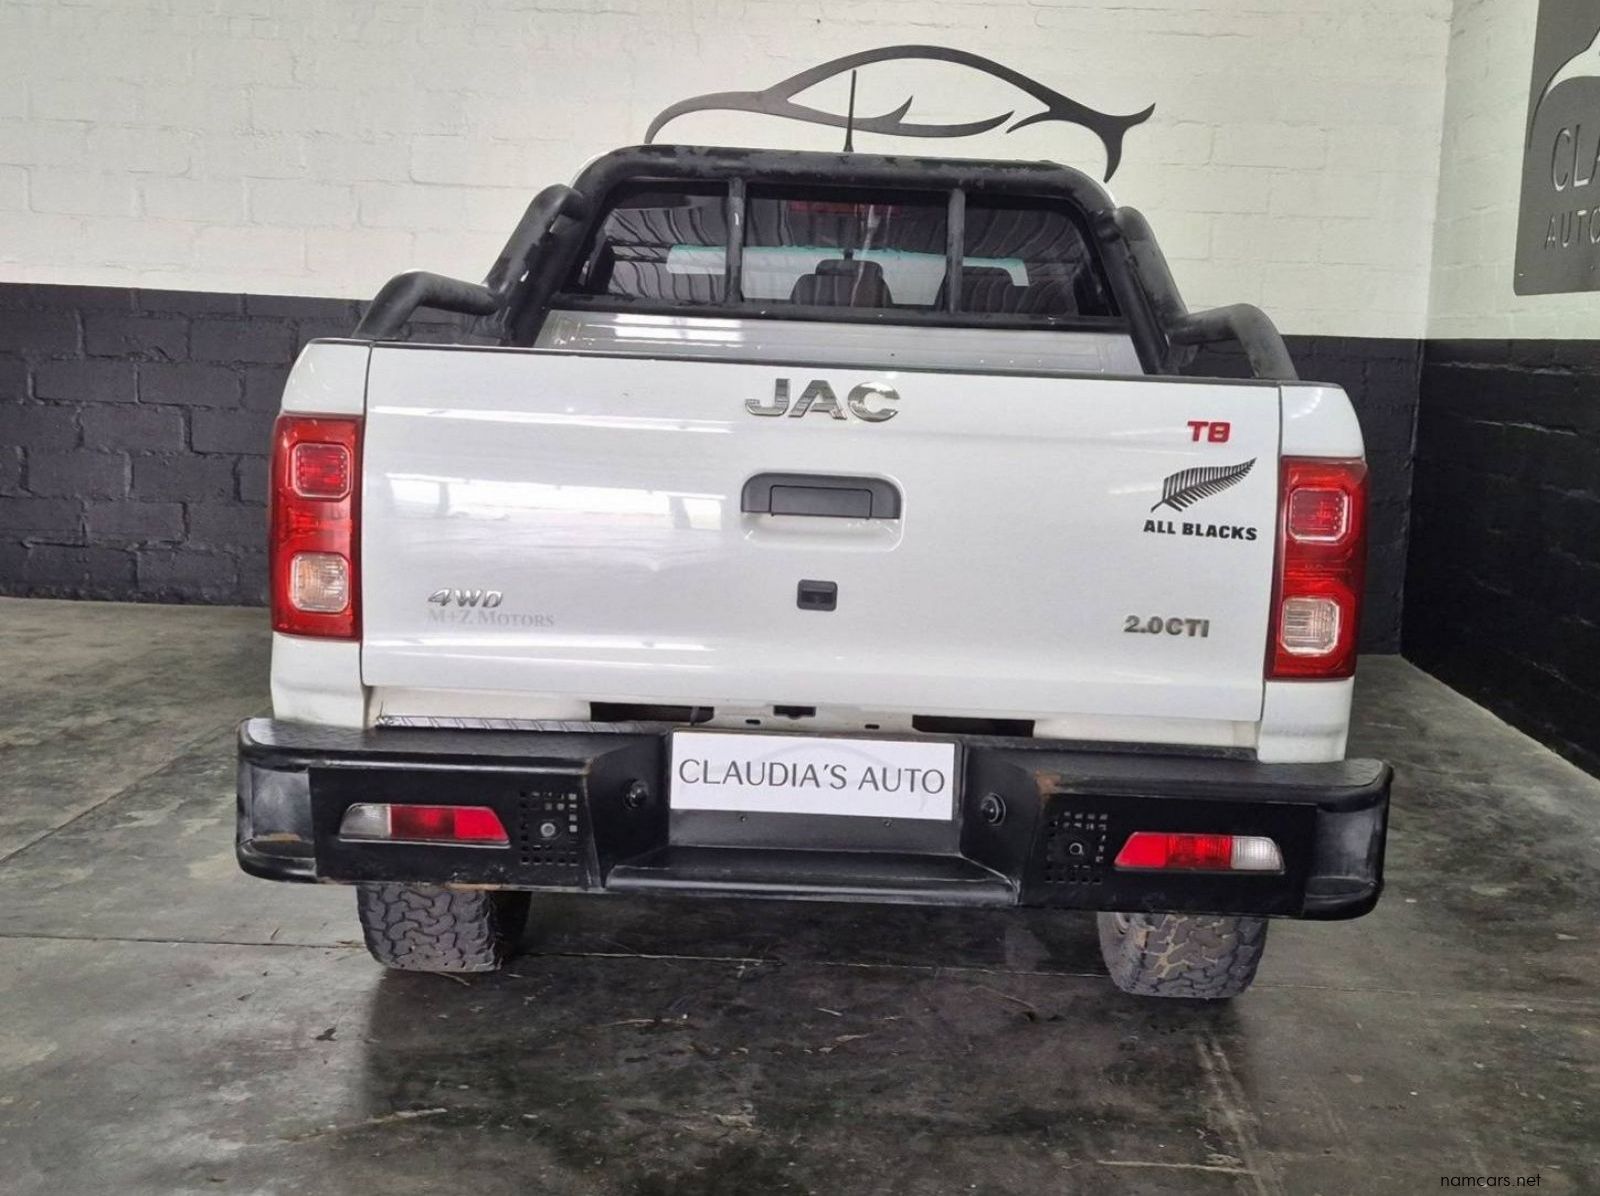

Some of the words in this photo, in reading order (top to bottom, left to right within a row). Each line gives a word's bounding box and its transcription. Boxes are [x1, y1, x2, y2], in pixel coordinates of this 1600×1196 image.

[745, 378, 901, 423] JAC
[1187, 420, 1231, 443] T8
[1143, 519, 1176, 535] ALL
[1182, 522, 1257, 541] BLACKS
[427, 588, 504, 608] 4WD
[1123, 615, 1210, 638] 2.0CTI
[678, 758, 848, 790] CLAUDIA'S
[858, 766, 945, 795] AUTO
